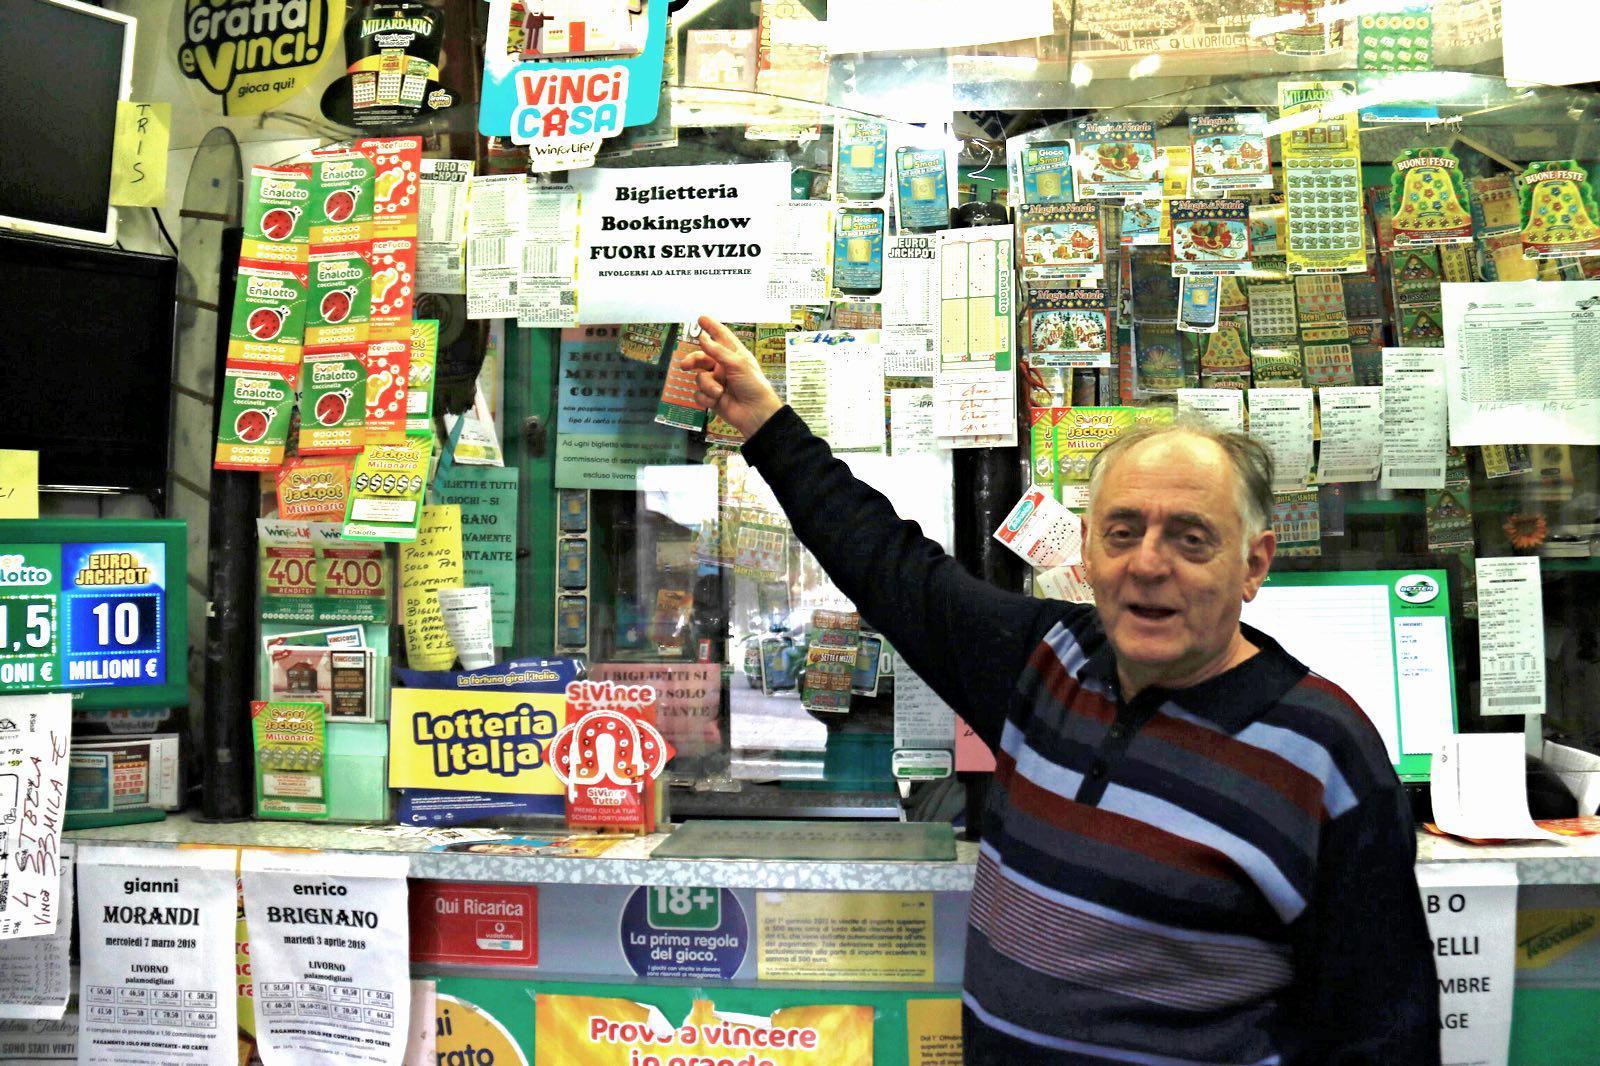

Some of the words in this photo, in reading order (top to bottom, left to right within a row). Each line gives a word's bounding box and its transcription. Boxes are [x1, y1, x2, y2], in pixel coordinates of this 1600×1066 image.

[188, 0, 306, 43] Gratta
[360, 16, 434, 38] MILIARDARIO
[1119, 40, 1161, 52] ULTRAS
[238, 80, 270, 97] gioca
[273, 77, 295, 93] qui!
[517, 102, 618, 138] CASA
[1086, 123, 1113, 133] Magia
[1397, 158, 1428, 170] BUONE
[1429, 158, 1456, 169] FESTE
[322, 169, 366, 180] Enalotto
[1525, 172, 1556, 184] BUONE
[1557, 172, 1584, 182] FESTE
[262, 187, 308, 198] Enalotto
[615, 184, 738, 205] Biglietteria
[1029, 204, 1057, 214] Magia
[1066, 203, 1096, 213] Natale
[1178, 201, 1204, 212] Magia
[1214, 200, 1245, 211] Natale
[600, 215, 752, 234] Bookingshow
[897, 238, 927, 248] EURO
[589, 244, 655, 261] FUORI
[660, 243, 762, 259] SERVIZIO
[888, 247, 936, 259] JACKPOT
[319, 269, 362, 280] Enalotto
[598, 269, 649, 277] RIVOLGERSI
[664, 268, 692, 276] ALTRE
[694, 268, 752, 276] BIGLIETTERIE
[249, 285, 297, 298] Enalotto
[1037, 290, 1065, 301] Magia
[1074, 290, 1104, 300] Natale
[314, 369, 357, 382] Enalotto
[235, 387, 284, 399] Enalotto
[1075, 414, 1113, 426] Super
[1067, 425, 1121, 439] Jackpot
[562, 439, 573, 447] Ad
[370, 449, 420, 461] Jackpot
[563, 456, 610, 464] commissione
[367, 460, 419, 470] Milionario
[583, 472, 610, 480] escluso
[612, 472, 636, 480] livorno
[489, 481, 517, 490] TUTTI
[285, 486, 344, 503] Jackpot
[446, 496, 480, 504] GIOCHI
[490, 497, 500, 505] SI
[286, 501, 345, 514] Milionario
[405, 547, 451, 558] PAGANO
[89, 552, 136, 570] EURO
[325, 560, 382, 588] 400
[404, 564, 429, 572] SOLO
[75, 568, 150, 586] JACKPOT
[403, 576, 458, 588] CONTANTE
[92, 602, 140, 646] 10
[820, 652, 836, 662] SETTE
[40, 661, 53, 681] €
[69, 659, 140, 681] MILIONI
[145, 657, 158, 678] €
[457, 675, 470, 685] La
[471, 674, 504, 685] fortuna
[505, 674, 524, 686] gira
[612, 671, 691, 681] BIGLIETTI
[694, 671, 708, 680] SI
[567, 683, 653, 702] SiVince
[666, 688, 706, 699] SOLO
[265, 719, 314, 732] Jackpot
[414, 704, 554, 742] Lotteria
[265, 733, 315, 742] Milionario
[435, 738, 542, 775] Italia
[124, 877, 180, 894] gianni
[293, 882, 347, 897] enrico
[653, 885, 715, 915] 18+
[435, 897, 459, 915] Qui
[464, 899, 524, 916] Ricarica
[102, 905, 201, 927] MORANDI
[266, 906, 379, 929] BRIGNANO
[144, 938, 150, 947] 7
[151, 939, 175, 948] marzo
[177, 939, 197, 949] 2018
[317, 936, 323, 946] 3
[324, 937, 347, 950] aprile
[347, 938, 366, 950] 2018
[630, 933, 647, 946] La
[650, 932, 690, 948] prima
[693, 934, 739, 951] regola
[650, 946, 673, 960] del
[675, 947, 717, 964] gioco.
[131, 964, 169, 974] LIVORNO
[308, 960, 346, 972] LIVORNO
[125, 976, 175, 986] palamodigliani
[304, 973, 353, 983] palamodigliani
[590, 1017, 673, 1044] Prov
[680, 1024, 697, 1044] a
[704, 1021, 817, 1048] vincere
[333, 1033, 361, 1043] CONTANTE
[375, 1040, 391, 1048] CARTE
[2, 1043, 25, 1053] SONO
[28, 1043, 50, 1054] STATI
[52, 1043, 75, 1054] VINTI
